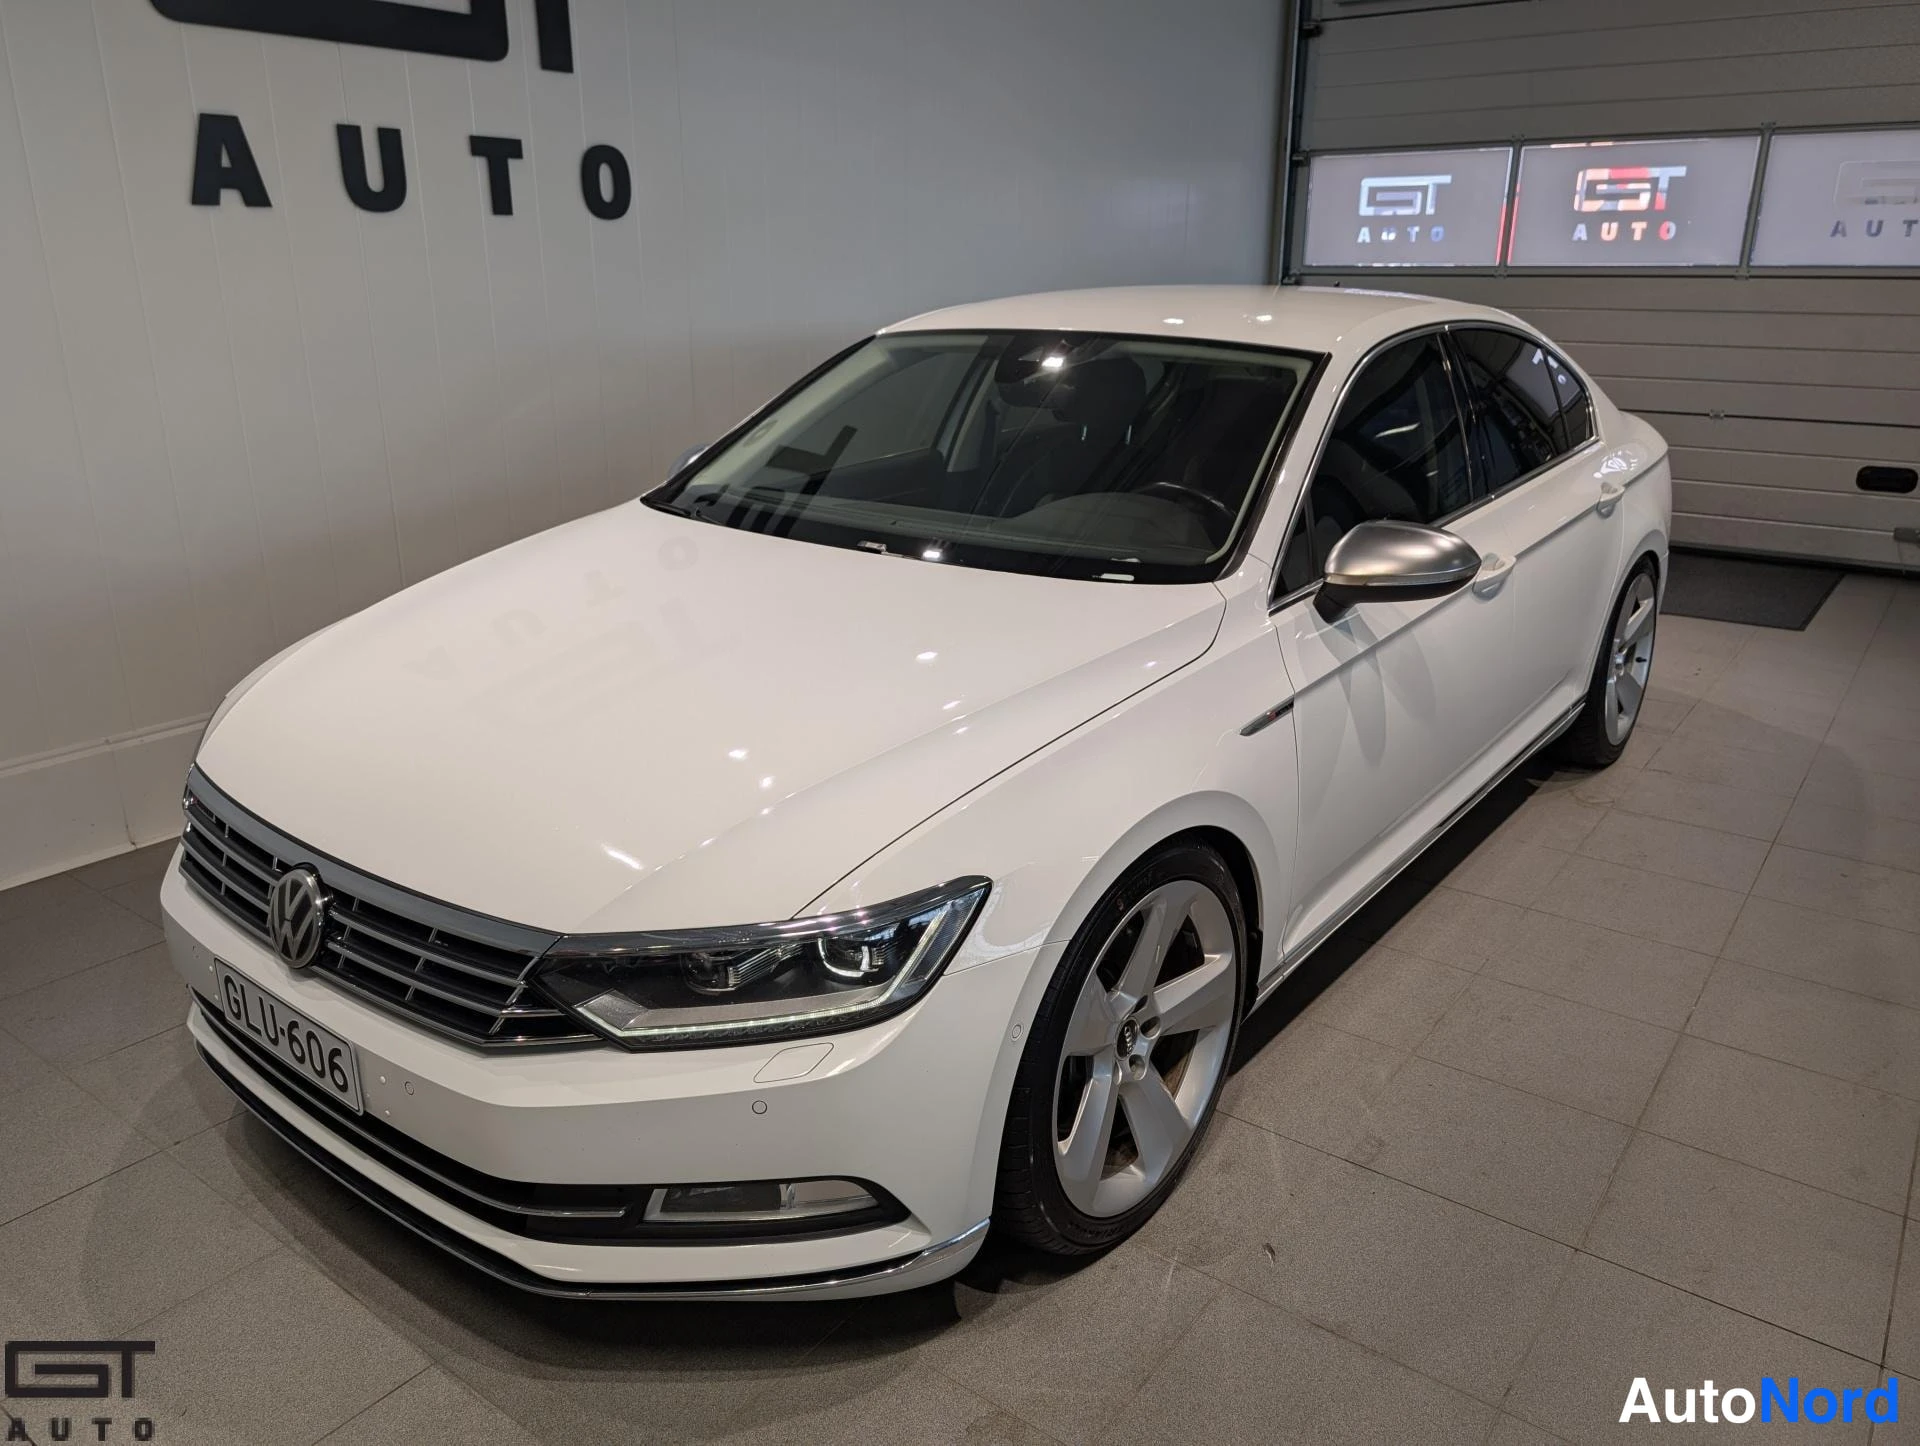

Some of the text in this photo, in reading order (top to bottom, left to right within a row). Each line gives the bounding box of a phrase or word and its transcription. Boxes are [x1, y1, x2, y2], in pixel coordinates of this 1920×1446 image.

[191, 112, 632, 221] AUTO
[1356, 224, 1445, 244] AUTO
[1571, 220, 1678, 242] AUTO
[223, 974, 349, 1094] GLU-606
